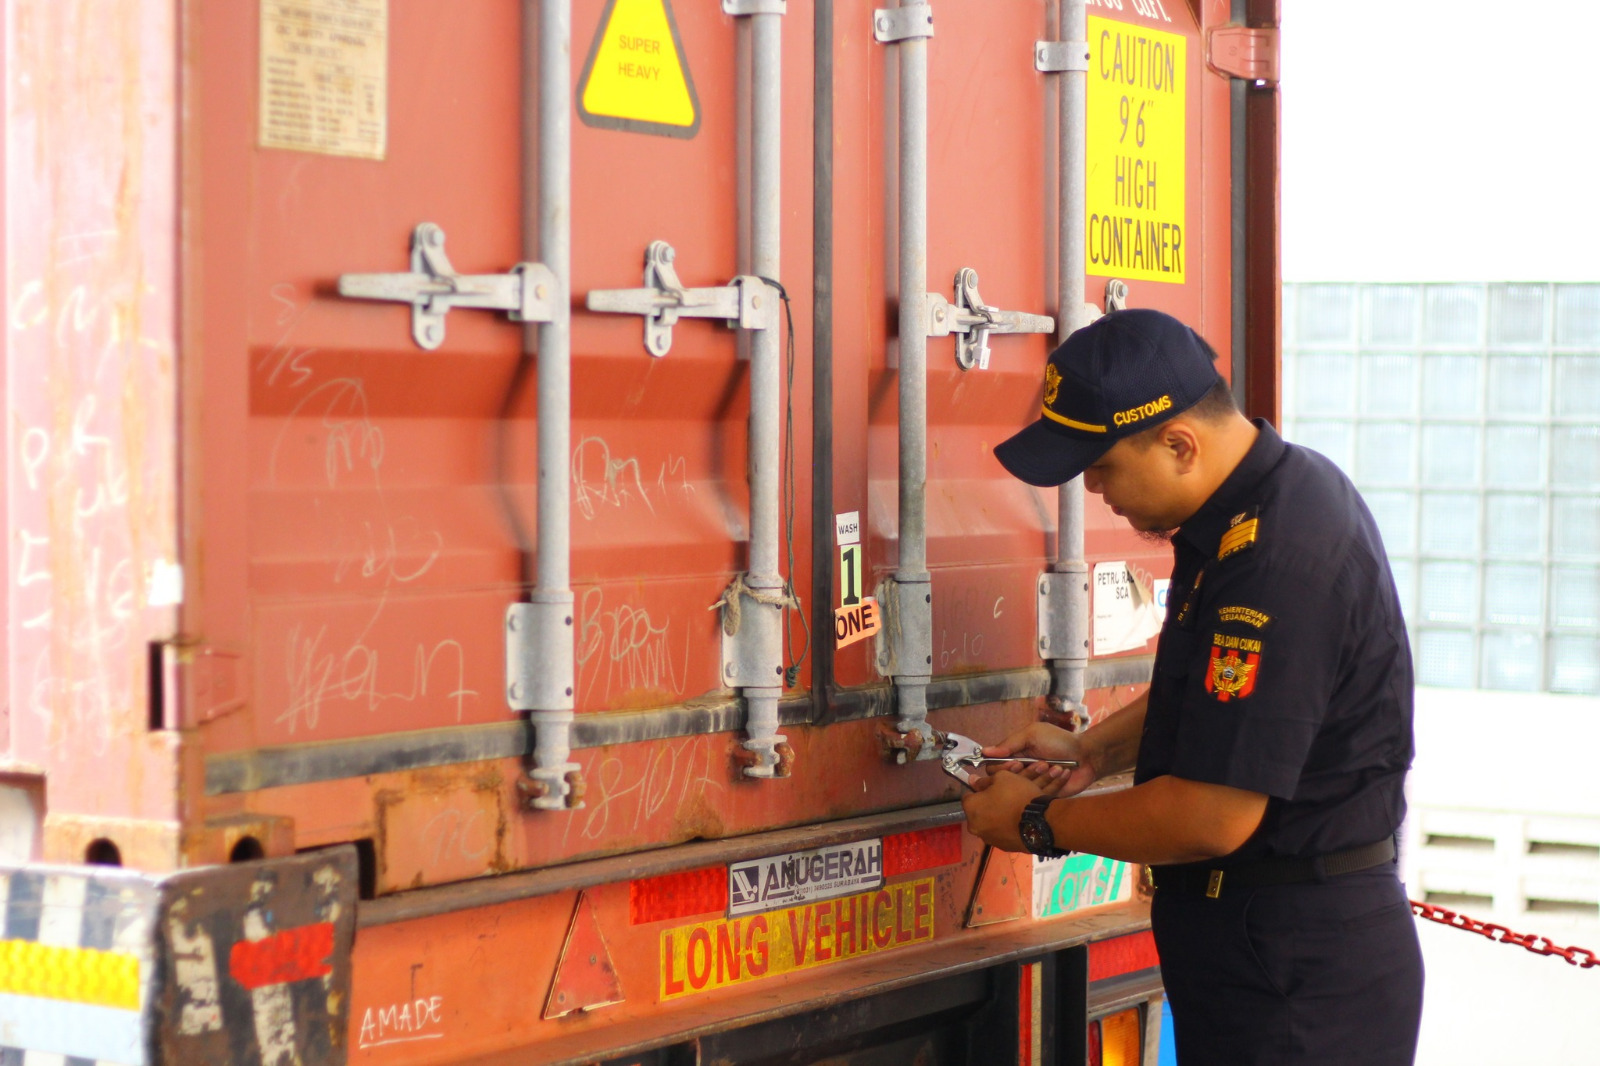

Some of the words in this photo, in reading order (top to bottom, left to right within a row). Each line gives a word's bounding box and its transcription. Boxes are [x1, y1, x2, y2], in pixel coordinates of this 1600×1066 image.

[619, 34, 661, 55] SUPER
[1100, 29, 1175, 94] CAUTION
[618, 62, 660, 81] HEAVY
[1115, 154, 1157, 211] HIGH
[1089, 213, 1182, 274] CONTAINER
[1113, 395, 1172, 425] CUSTOMS
[838, 523, 858, 535] WASH
[842, 547, 860, 606] 1
[836, 604, 875, 641] ONE
[1218, 606, 1269, 623] KEMENTERIAN
[1220, 614, 1263, 628] KEUANGAN
[1213, 633, 1225, 646] BEA
[1225, 636, 1240, 649] DAN
[1240, 638, 1262, 653] CUKAI
[761, 845, 881, 901] ANUGERAH
[664, 914, 769, 996] LONG
[787, 882, 930, 967] VEHICLE
[359, 995, 443, 1045] AMADE
